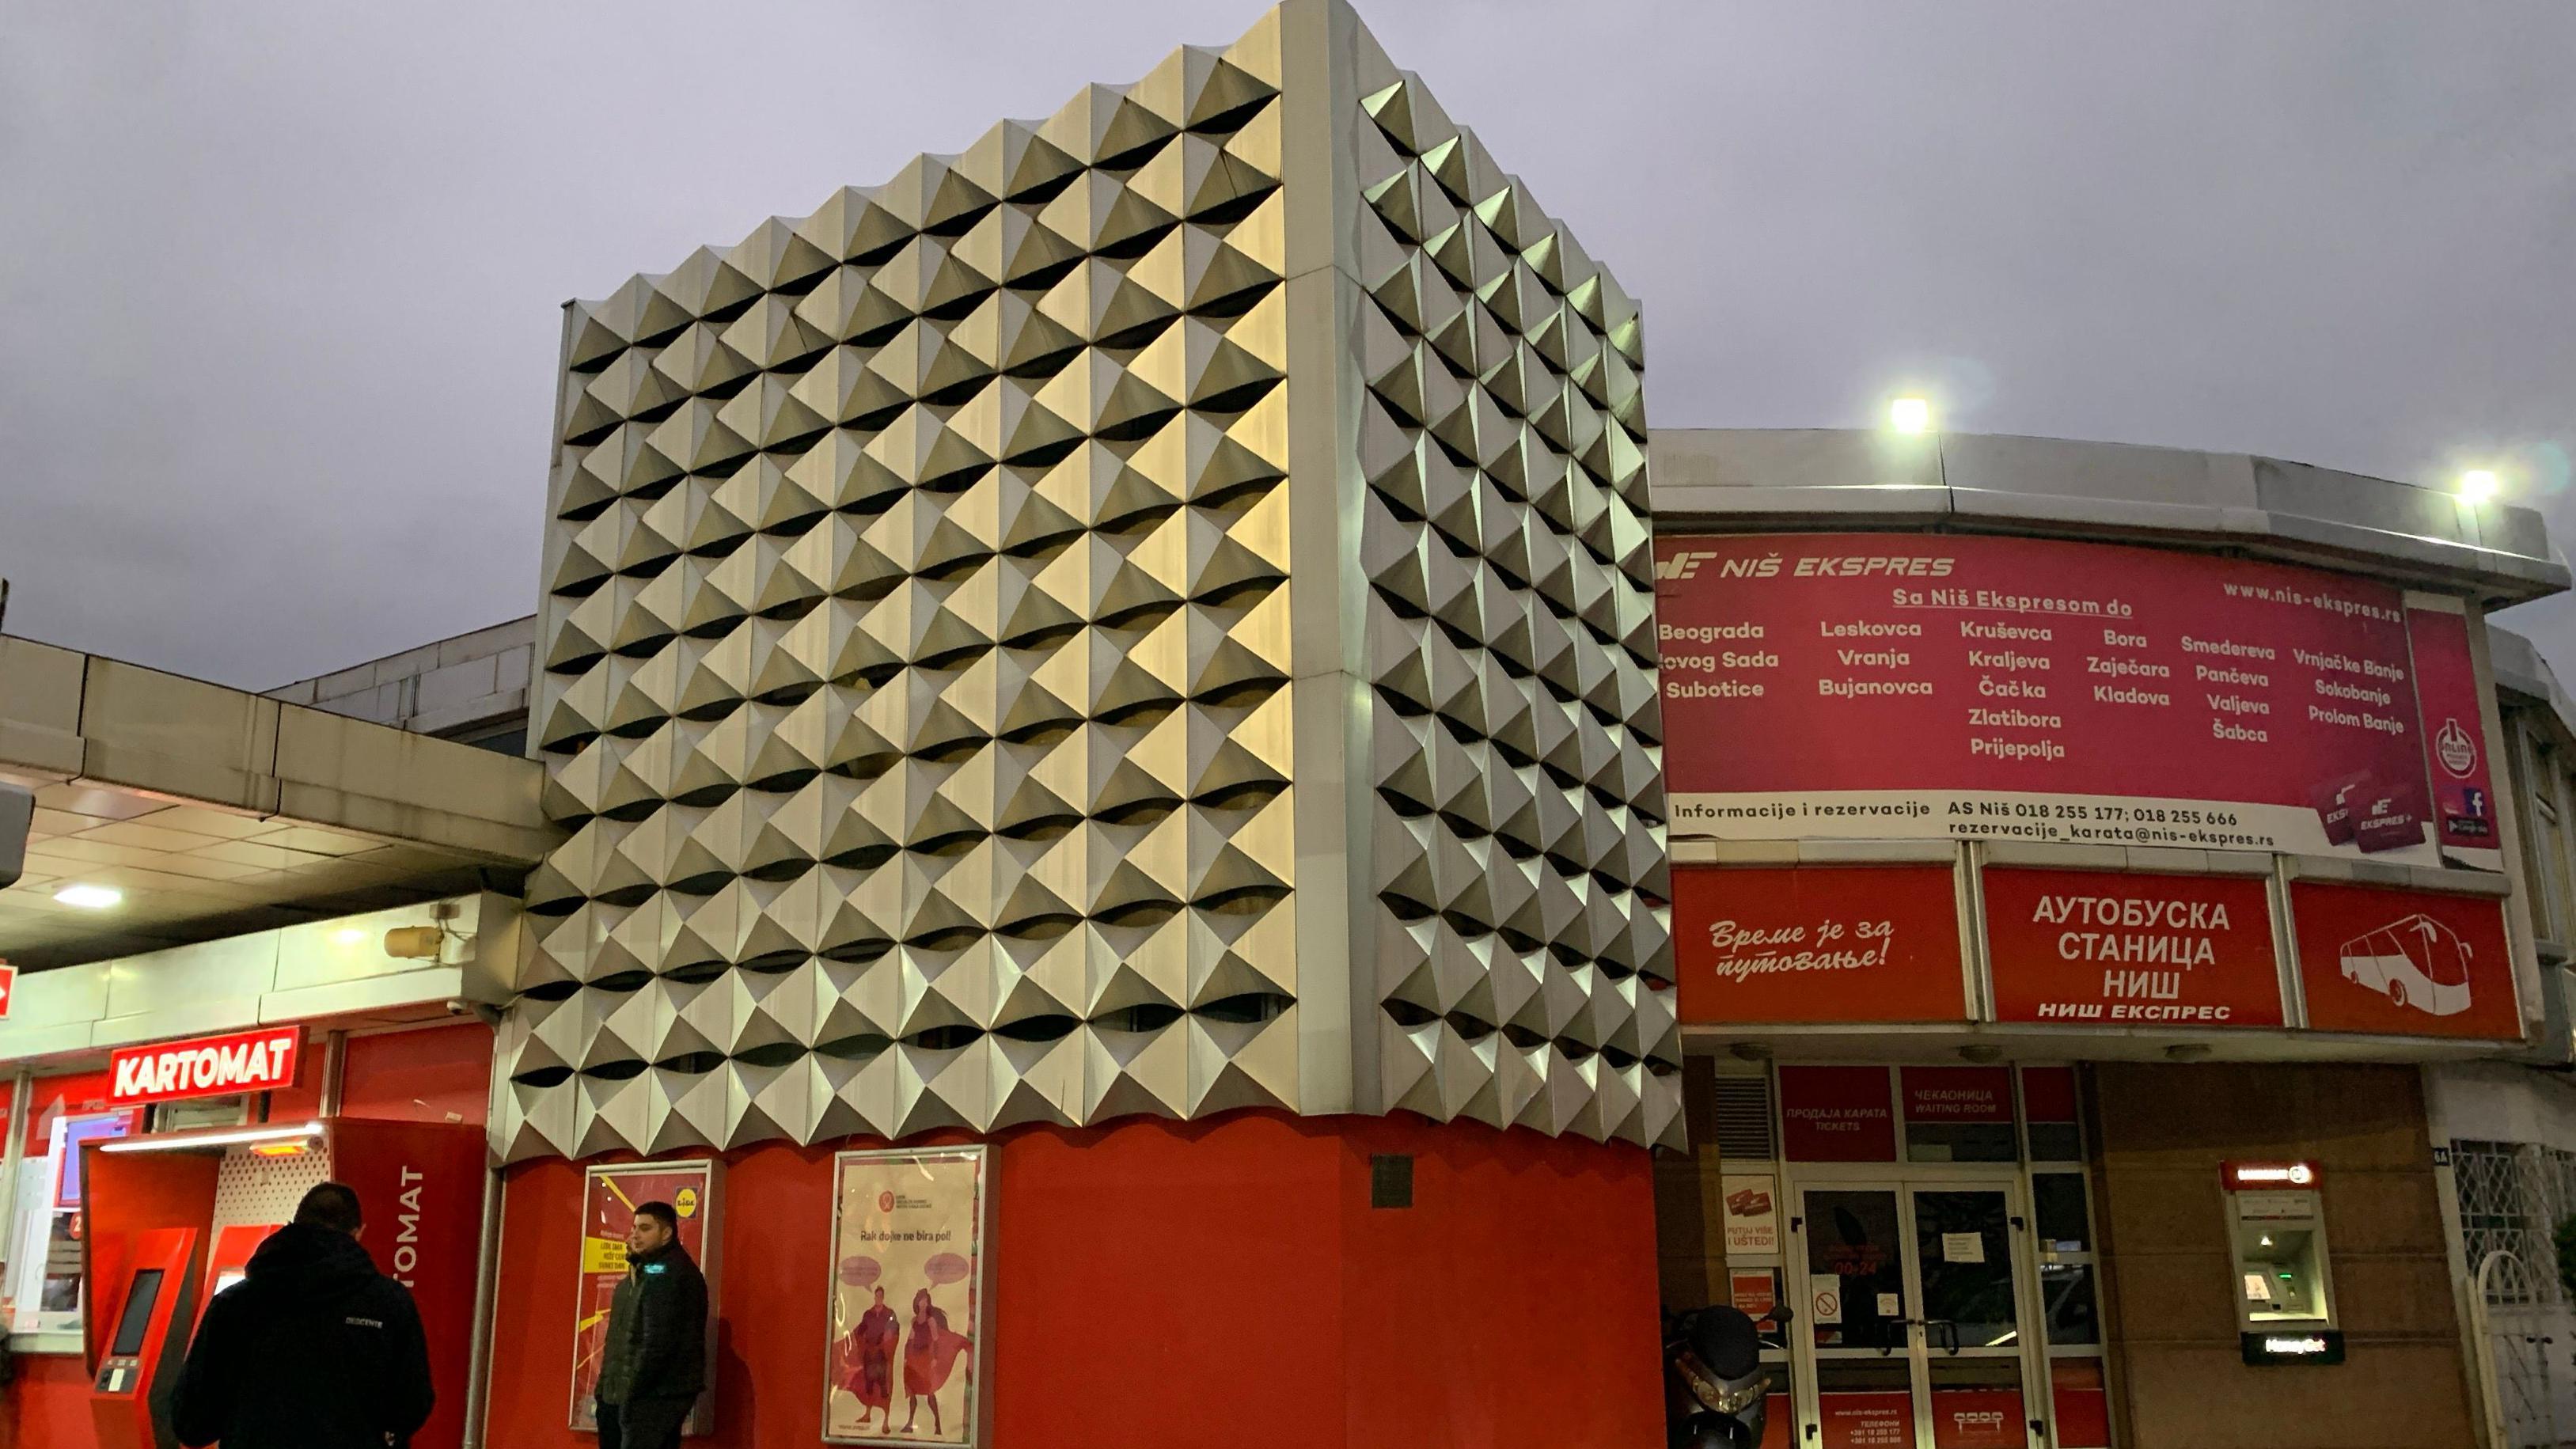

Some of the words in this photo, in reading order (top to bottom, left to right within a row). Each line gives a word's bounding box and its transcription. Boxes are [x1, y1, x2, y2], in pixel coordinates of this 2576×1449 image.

[1720, 553, 1783, 578] NIŠ
[1793, 557, 1955, 576] EKSPRES
[1893, 588, 1923, 606] Sa
[1931, 589, 1969, 606] Niš
[1977, 590, 2100, 614] Ekspresom
[2107, 601, 2133, 617] do
[2224, 582, 2402, 623] www.nis-ekspres.rs
[1659, 622, 1764, 643] Beograda
[1820, 620, 1922, 638] Leskovca
[1960, 620, 2053, 642] Kruševca
[2104, 630, 2147, 649] Bora
[1722, 650, 1779, 668] Sada
[1837, 648, 1910, 669] Vranja
[2181, 635, 2276, 661] Smedereva
[1968, 651, 2051, 672] Kraljeva
[2087, 656, 2170, 681] Zaječara
[2293, 648, 2361, 676] Vrnjačke
[2364, 659, 2405, 681] Banje
[2195, 665, 2269, 688] Pančeva
[1666, 680, 1764, 699] Subotice
[1819, 677, 1933, 700] Bujanovca
[2094, 685, 2170, 706] Kladova
[2316, 678, 2391, 706] Sokobanje
[2206, 693, 2270, 716] Valjeva
[1968, 708, 2062, 729] Zlatibora
[2309, 705, 2361, 730] Prolom
[2363, 714, 2405, 735] Banje
[2213, 719, 2267, 742] Šabca
[1971, 738, 2065, 761] Prijepolja
[1675, 803, 1796, 820] Informacije
[1803, 802, 1808, 817] i
[1815, 802, 1930, 819] rezervacije
[1948, 802, 1974, 816] AS
[1980, 802, 2011, 817] Niš
[2015, 803, 2050, 818] 018
[2055, 805, 2088, 820] 255
[2095, 806, 2130, 823] 177;
[2134, 808, 2165, 823] 018
[2171, 810, 2202, 825] 255
[2206, 811, 2237, 827] 666
[2360, 815, 2404, 831] EKSPRES
[2032, 895, 2231, 931] АУТОБУСКА
[1709, 920, 1805, 954] Време
[1816, 918, 1846, 944] је
[1856, 920, 1895, 939] за
[2058, 931, 2215, 969] СТАНИЦА
[2103, 970, 2180, 1000] НИШ
[2038, 1003, 2102, 1018] НИШ
[2111, 1004, 2231, 1020] ЕКСПРЕС
[114, 1038, 292, 1098] KARTOMAT
[1914, 1090, 1994, 1102] ЧЕКАОНИЦА
[1786, 1109, 1841, 1120] ПРОДАЈА
[1844, 1108, 1887, 1119] КАРАТА
[1914, 1103, 1961, 1113] WAITING
[1963, 1103, 1997, 1113] ROOM
[1815, 1121, 1861, 1132] TICKETS
[861, 1231, 876, 1242] Rak
[878, 1231, 901, 1243] dojke
[903, 1232, 915, 1241] ne
[916, 1230, 934, 1241] bira
[1727, 1227, 1753, 1235] PUTUJ
[1756, 1225, 1774, 1235] VIŠE
[1734, 1235, 1774, 1246] UŠTEDI!
